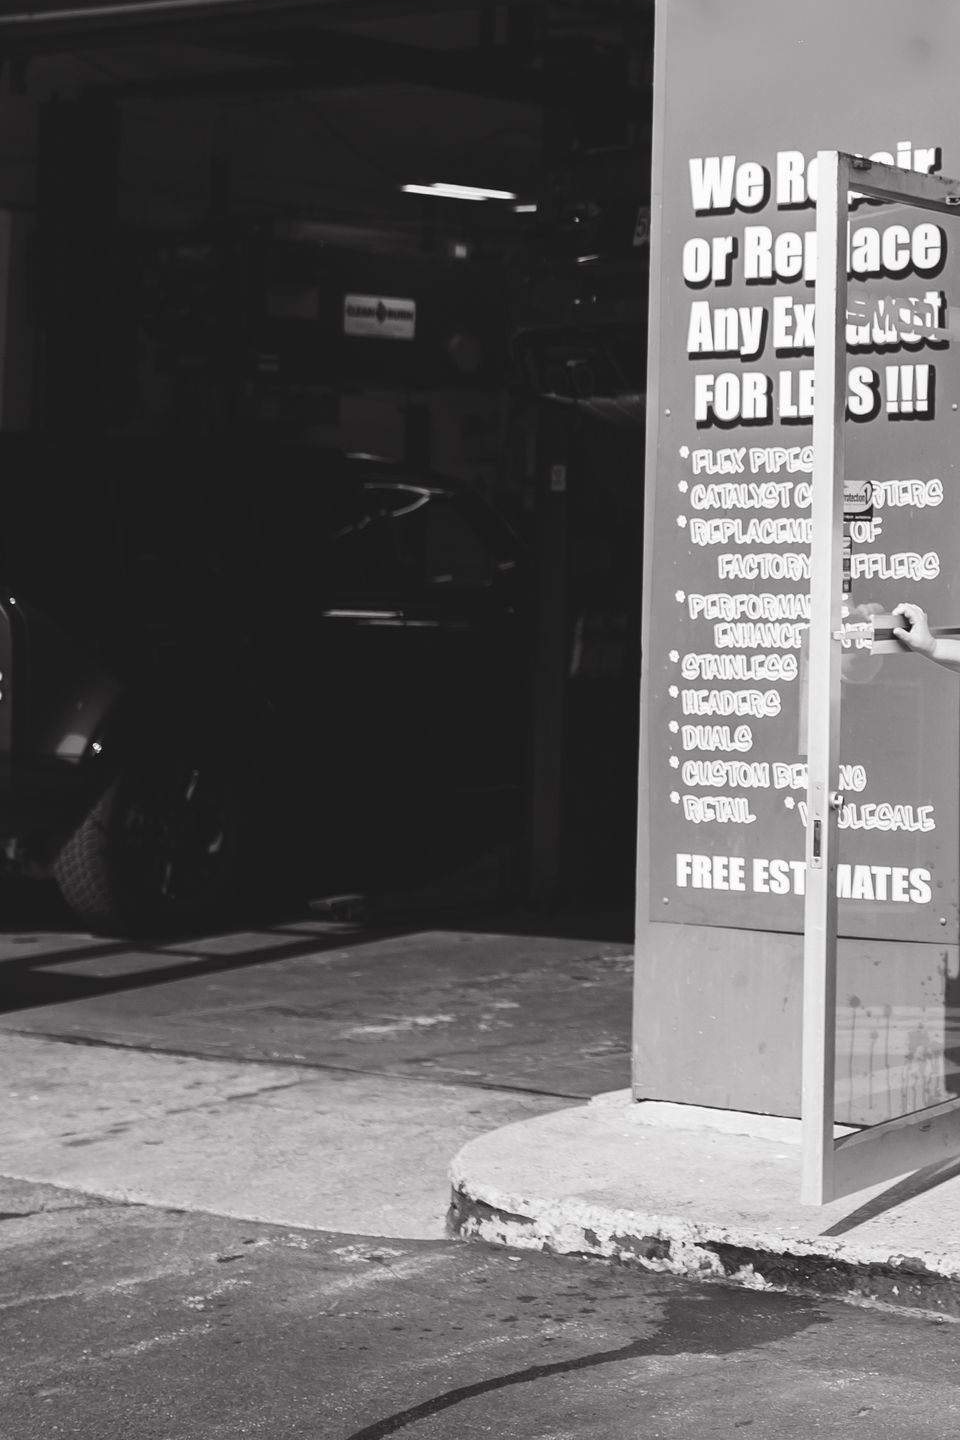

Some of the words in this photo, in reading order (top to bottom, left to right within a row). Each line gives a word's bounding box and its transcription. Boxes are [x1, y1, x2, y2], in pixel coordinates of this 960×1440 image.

[688, 155, 766, 210] We
[682, 236, 735, 283] or
[743, 223, 943, 281] Reace
[686, 301, 765, 356] Any
[694, 372, 769, 421] FOR
[778, 366, 876, 418] LES
[691, 447, 746, 475] FLEX
[749, 445, 814, 474] PIPES
[690, 480, 793, 510] CATALYST
[850, 517, 883, 544] OF
[681, 653, 798, 681] STAINLESS
[681, 689, 782, 718] HEADERS
[681, 725, 753, 752] DUALS
[682, 760, 770, 789] CUSTOM
[682, 794, 757, 824] RETAIL
[676, 853, 747, 891] FREE
[752, 858, 933, 904] ESTMATES
